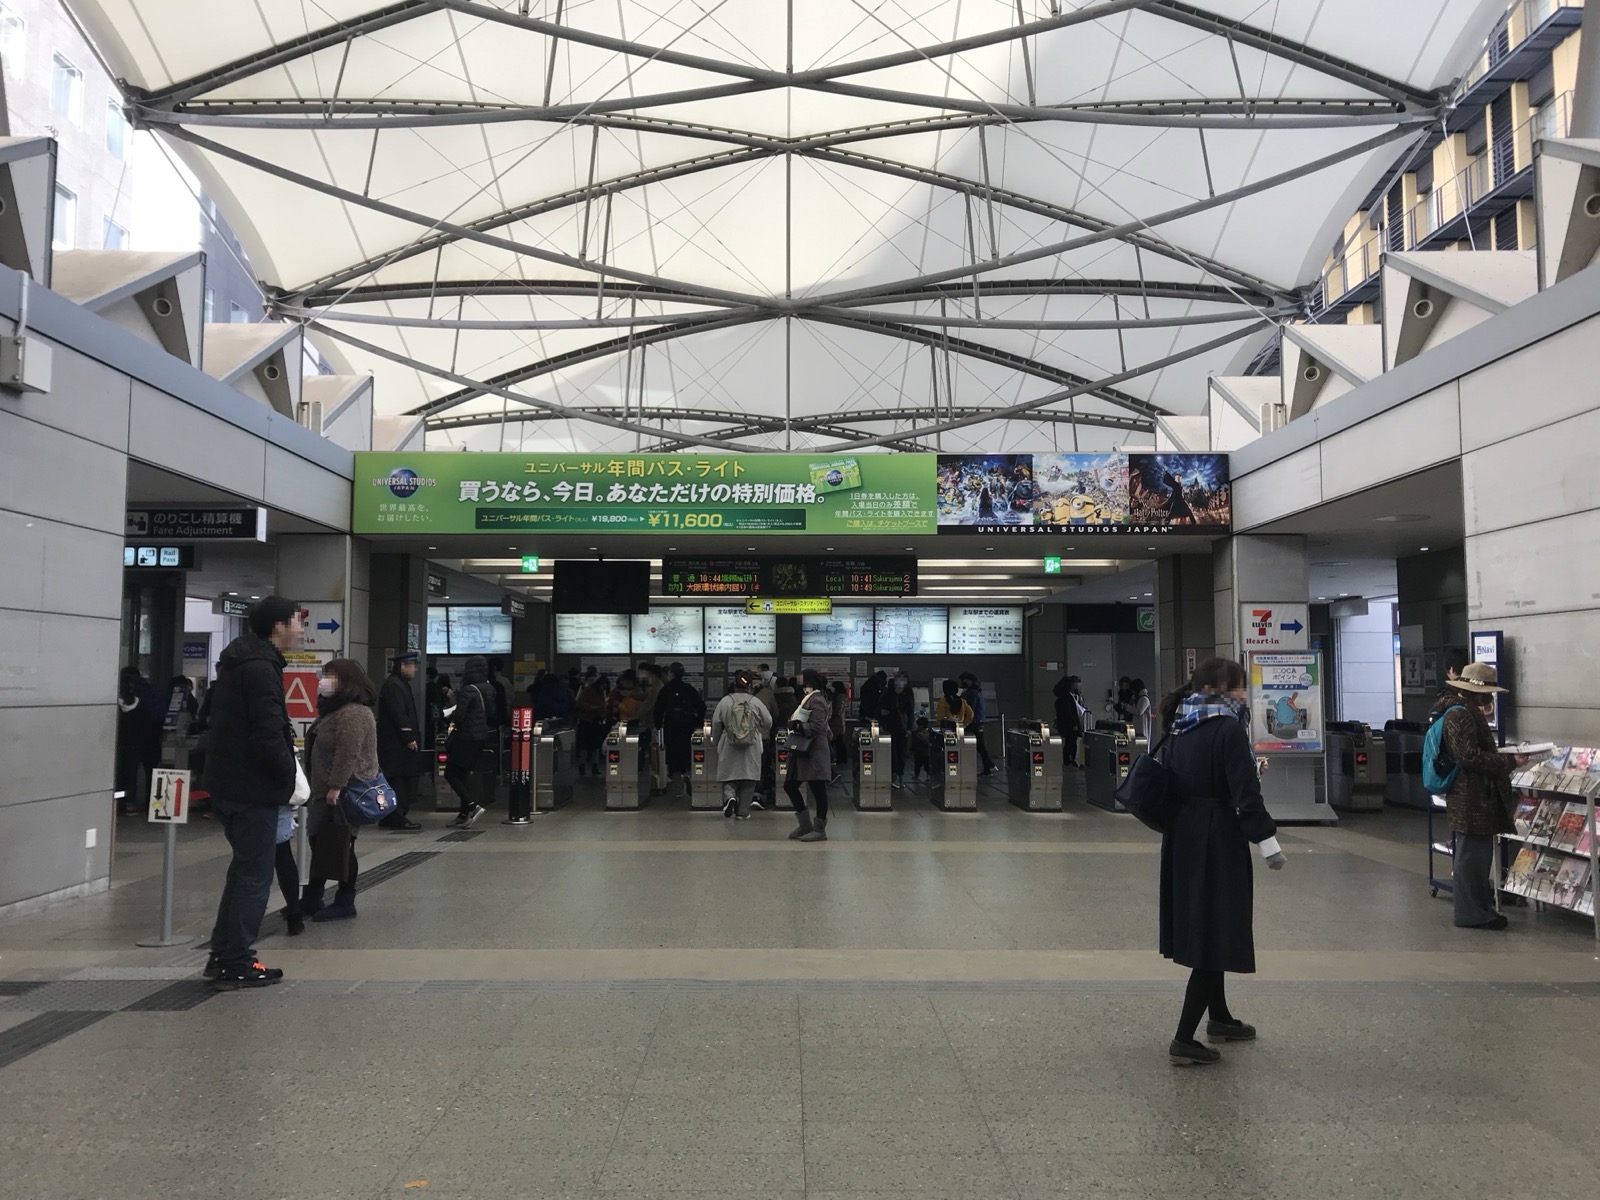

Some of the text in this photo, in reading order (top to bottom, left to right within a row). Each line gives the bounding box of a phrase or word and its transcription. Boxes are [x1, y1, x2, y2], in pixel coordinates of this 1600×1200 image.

[372, 477, 437, 487] UNIVERSAL STUDIOS
[153, 512, 242, 525] のりこし精算機
[648, 513, 722, 529] ¥11,600
[153, 526, 233, 536] Fare Adjustment
[699, 574, 720, 582] 10:44
[825, 574, 910, 583] Local 10:41 Sakurajima 2
[825, 583, 910, 592] Local 10:49 Sakurajima 2
[523, 710, 531, 727] 出口
